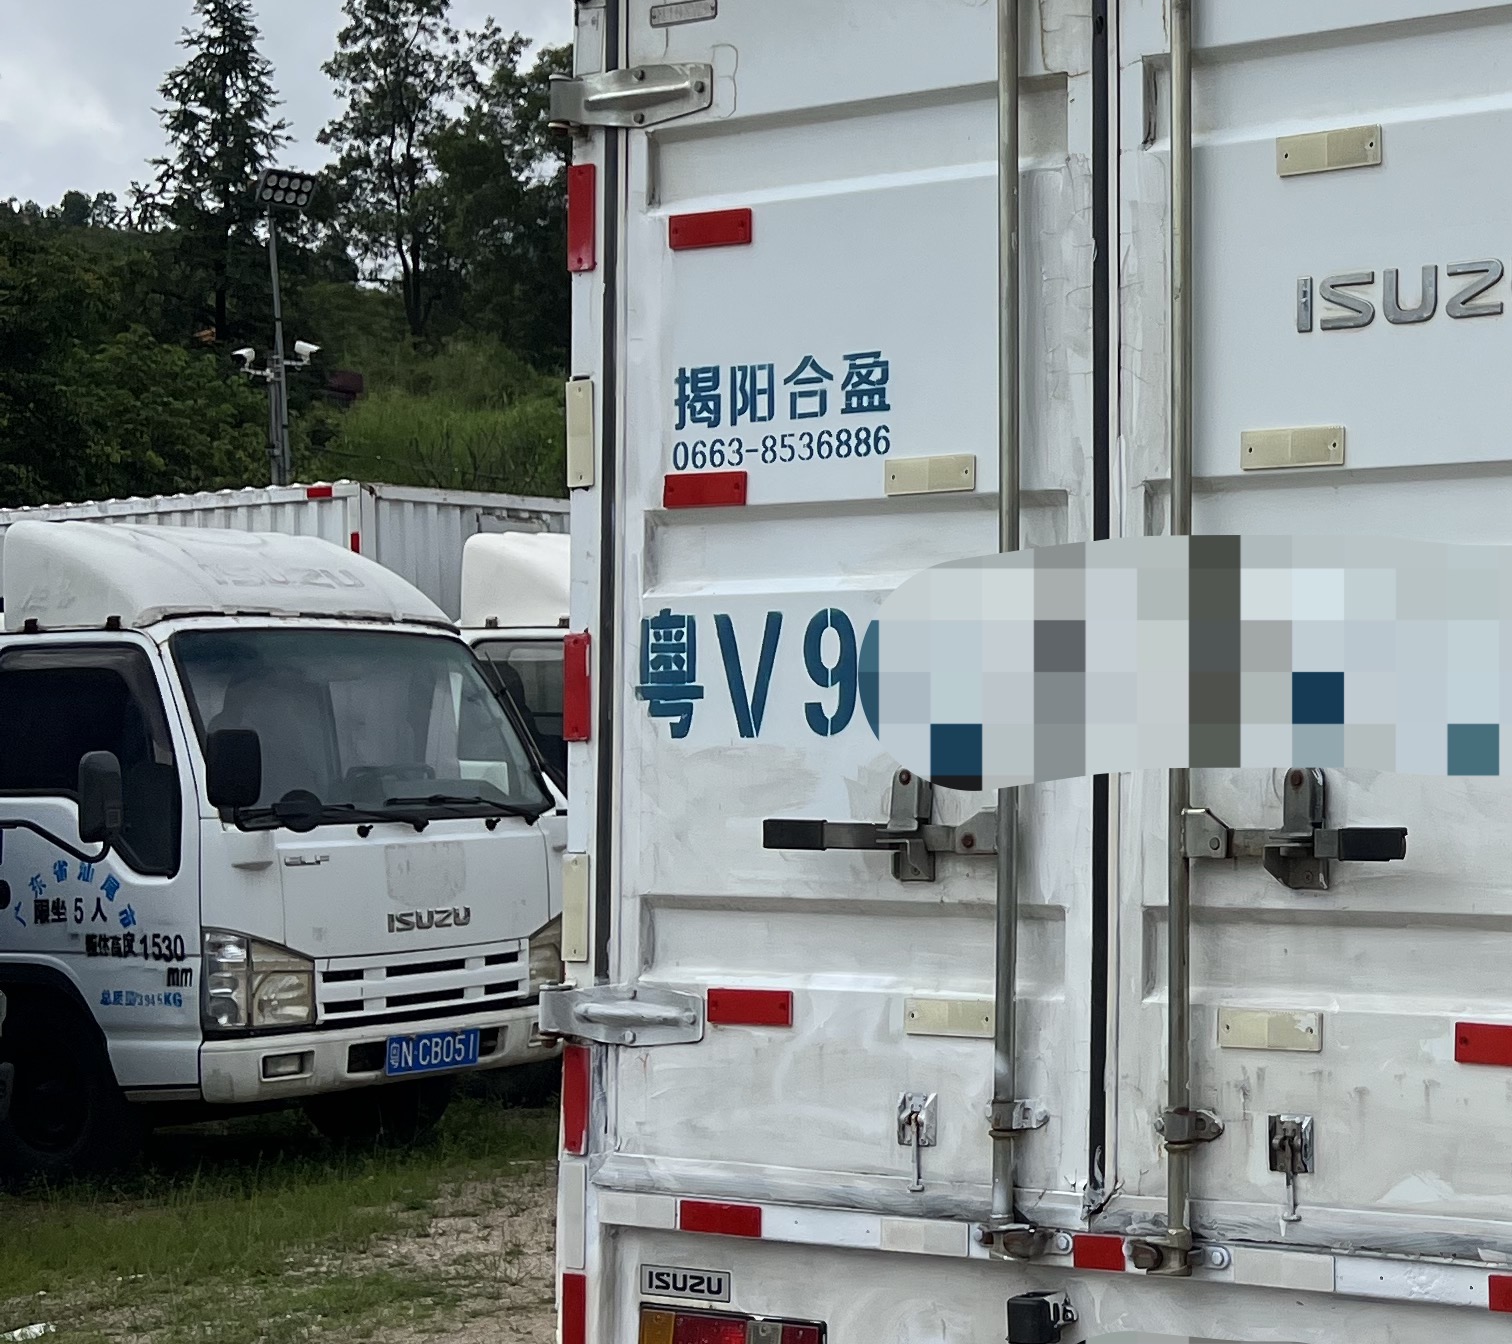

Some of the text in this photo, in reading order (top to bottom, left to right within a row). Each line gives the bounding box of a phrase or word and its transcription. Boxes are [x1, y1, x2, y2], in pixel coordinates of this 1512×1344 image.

[674, 350, 891, 430] 揭阳合盈
[673, 424, 891, 471] 0663-8536886
[387, 906, 471, 933] ISUZU
[648, 1270, 722, 1295] ISUZU
